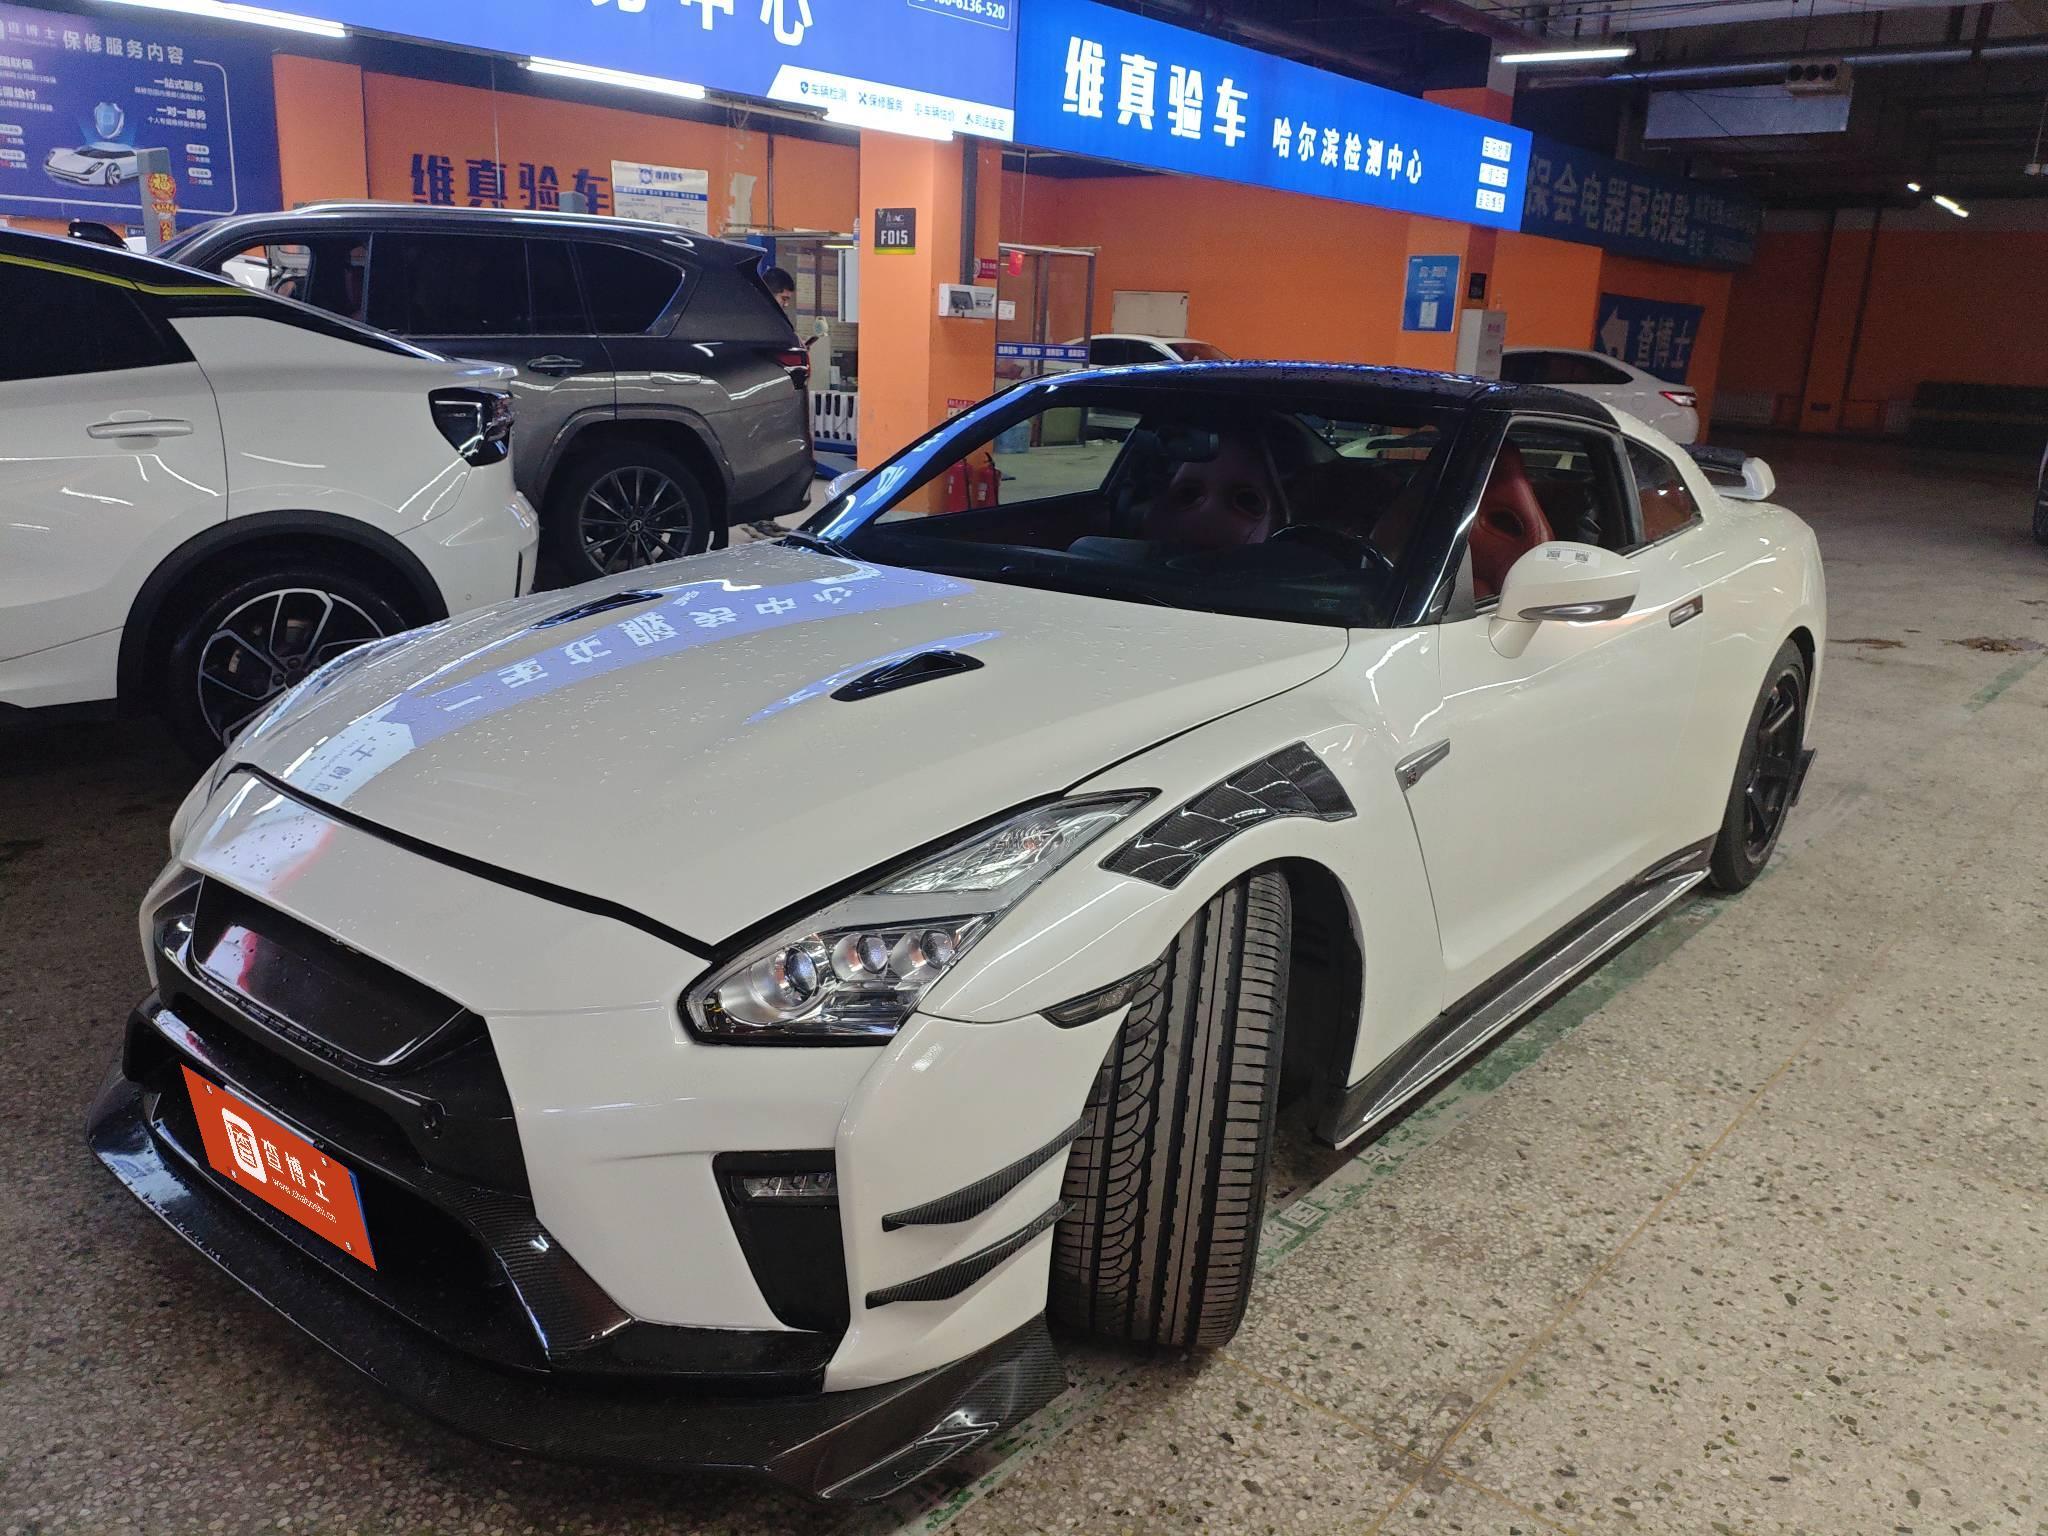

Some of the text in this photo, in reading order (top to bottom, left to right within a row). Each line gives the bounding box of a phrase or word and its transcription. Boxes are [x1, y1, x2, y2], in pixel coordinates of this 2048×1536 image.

[63, 30, 184, 66] 保修服务内容
[811, 84, 847, 102] 车辆检测
[869, 94, 904, 111] 保修服务
[1062, 36, 1422, 185] 维真验车 哈尔滨检测中心
[411, 153, 609, 213] 维真验车
[1633, 315, 1691, 369] 查博士
